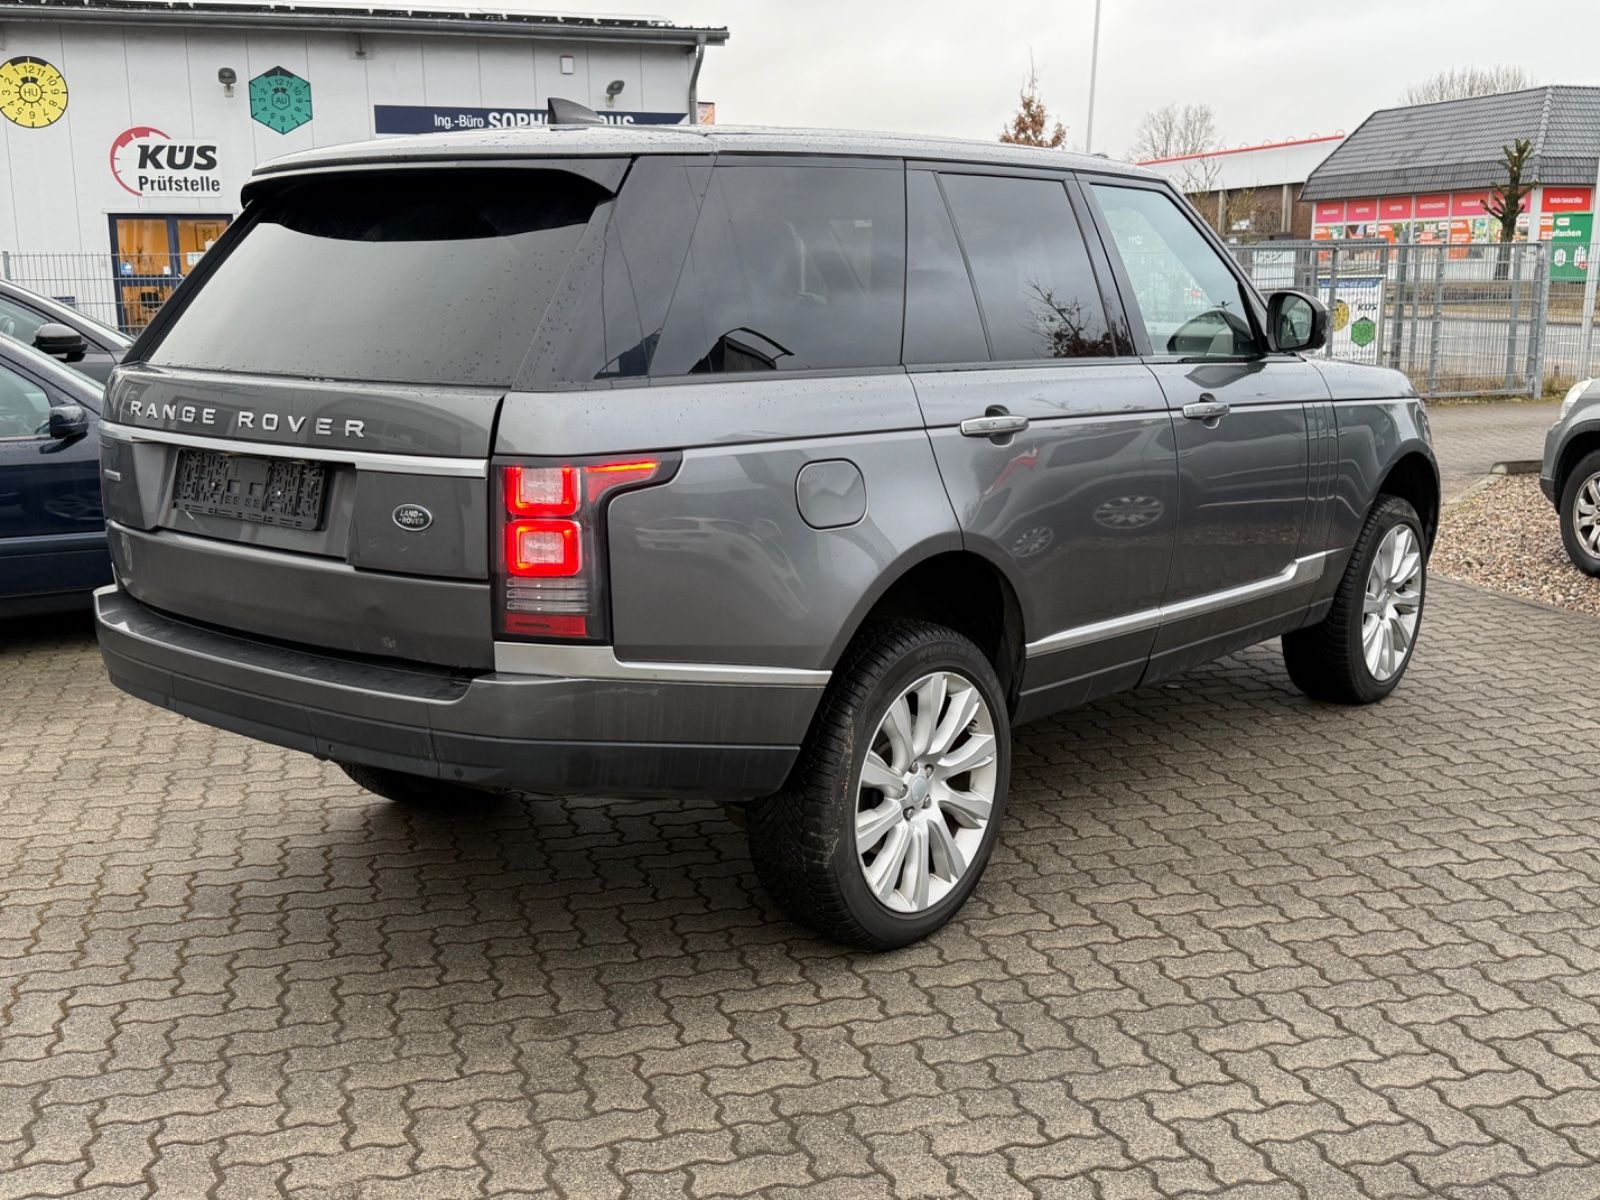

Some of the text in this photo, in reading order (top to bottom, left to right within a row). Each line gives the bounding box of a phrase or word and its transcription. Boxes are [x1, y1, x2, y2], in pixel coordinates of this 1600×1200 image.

[24, 65, 35, 74] 12
[37, 68, 46, 77] 11
[4, 77, 13, 85] 2
[47, 76, 57, 86] 10
[23, 88, 38, 97] HU
[275, 97, 288, 105] AU
[16, 107, 24, 115] 5
[29, 111, 35, 119] 6
[43, 108, 49, 116] 7
[434, 114, 485, 130] Ing.-Büro
[137, 144, 217, 170] KÜS
[138, 175, 221, 192] Prüfstelle
[130, 400, 365, 438] RANGE ROVER
